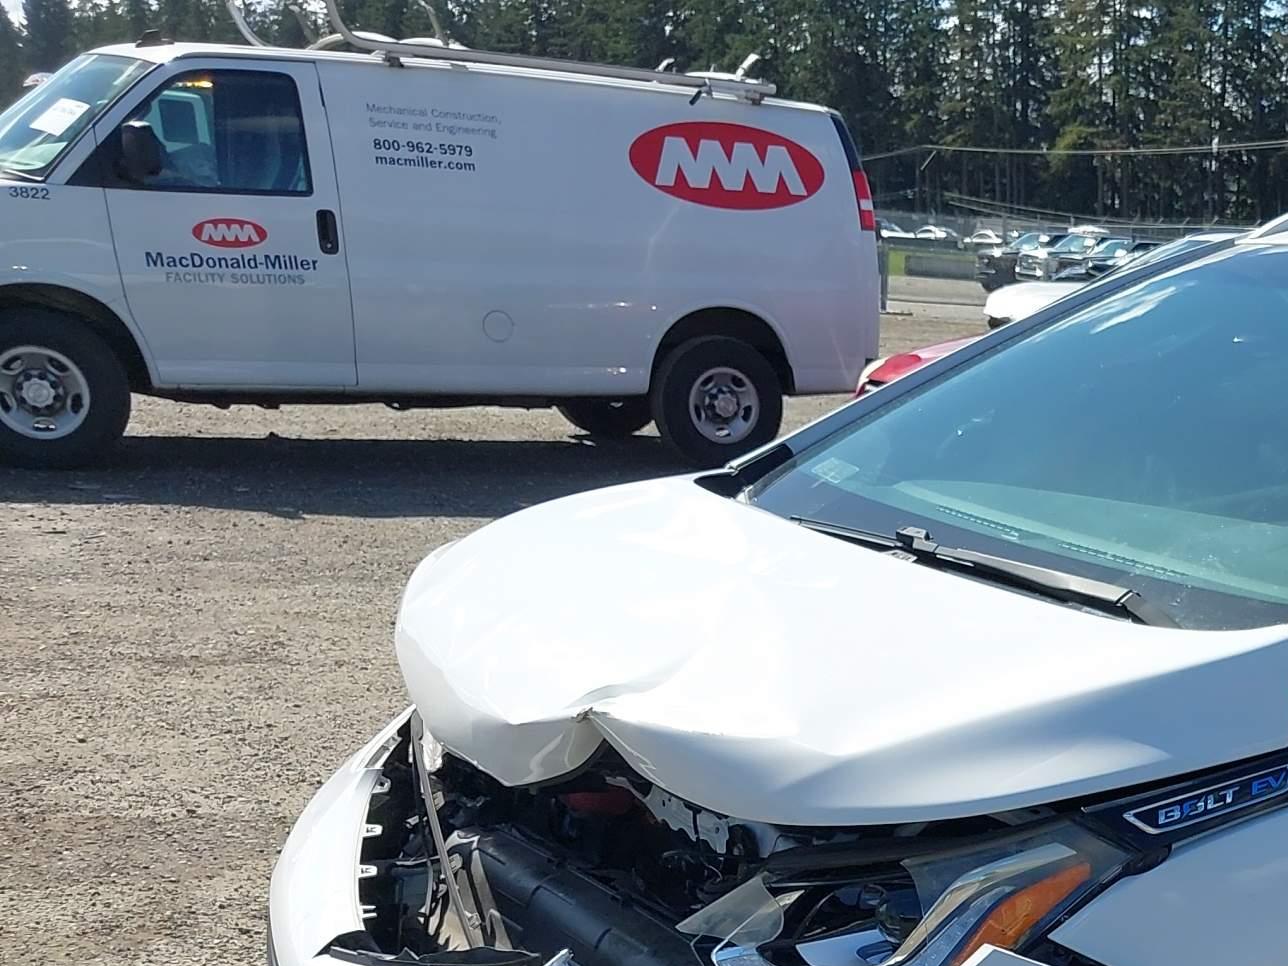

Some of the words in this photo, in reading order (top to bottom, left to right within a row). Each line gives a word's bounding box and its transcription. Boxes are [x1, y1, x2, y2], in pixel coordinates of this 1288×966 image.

[366, 102, 428, 117] Mechanical
[431, 108, 502, 124] Construction,
[368, 117, 409, 130] Service
[412, 122, 433, 132] and
[436, 123, 497, 139] Engineering
[373, 138, 473, 157] 800-962-5979
[375, 154, 476, 171] macmiller.com
[9, 186, 50, 200] 3822
[145, 252, 318, 271] MacDonald-Miller
[166, 272, 225, 284] FACILITY
[230, 273, 305, 285] SOLUTIONS
[1251, 772, 1286, 796] EV
